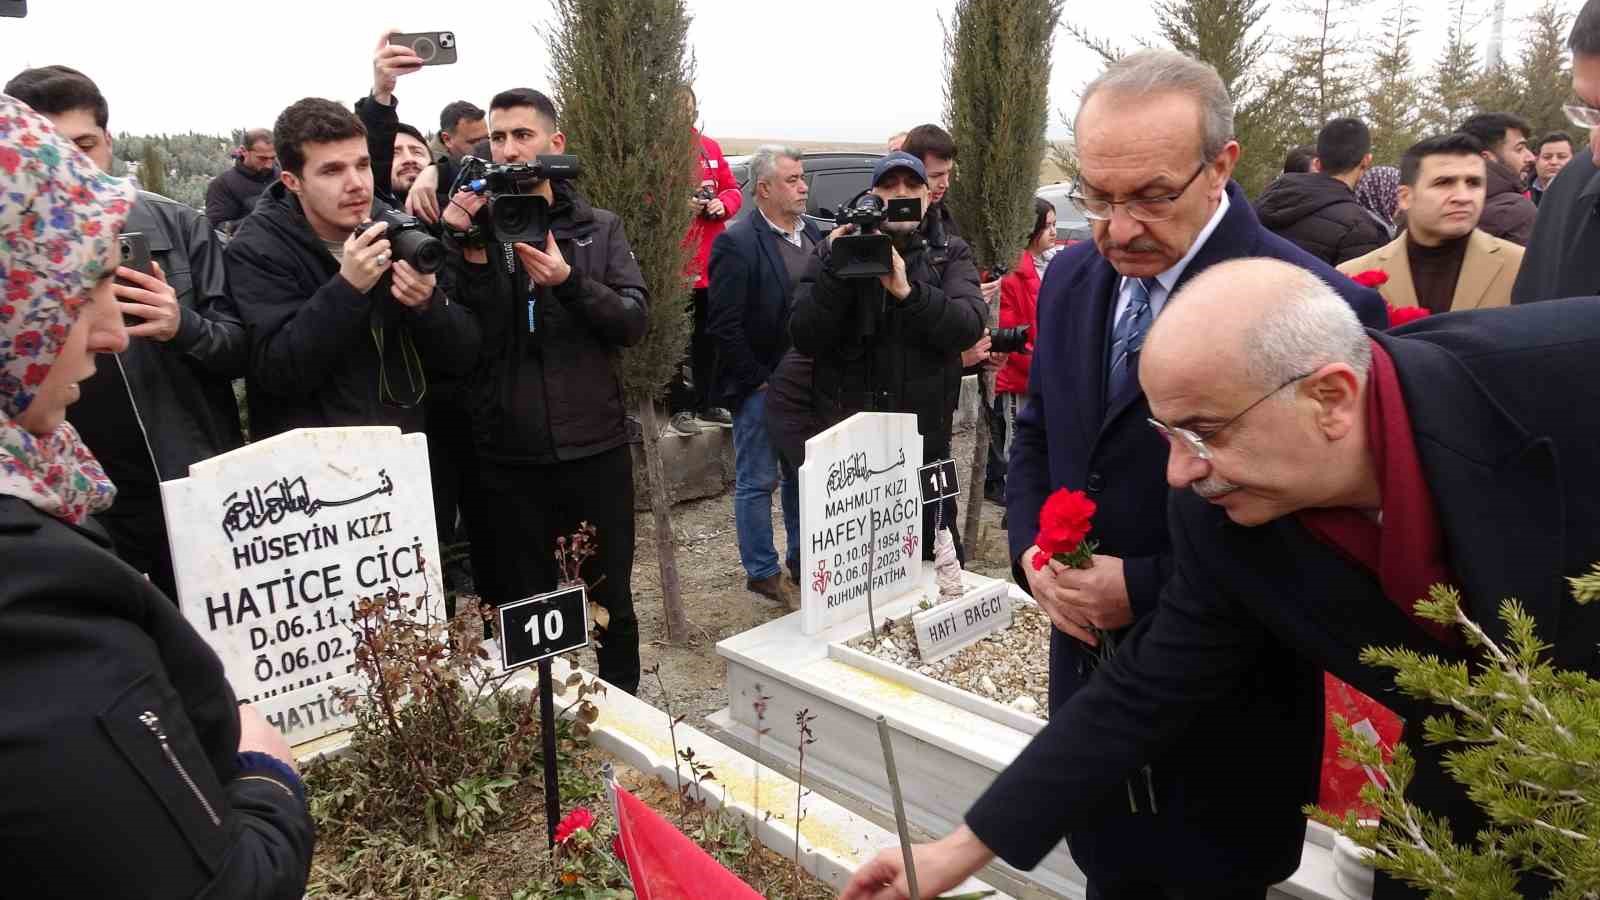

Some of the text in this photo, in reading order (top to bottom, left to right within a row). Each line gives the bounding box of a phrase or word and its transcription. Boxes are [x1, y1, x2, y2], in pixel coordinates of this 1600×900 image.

[825, 477, 907, 519] MAHMUT KIZI
[930, 471, 948, 492] 11
[233, 511, 393, 570] HÜSEYİN KIZI
[812, 496, 918, 554] HAFEY BAĞCI
[206, 535, 425, 630] HATİCE CİCİ
[827, 566, 907, 609] RUHUNA FATİHA
[834, 549, 901, 586] Ö.06.0.2023
[524, 609, 564, 646] 10
[929, 612, 957, 642] HAFİ
